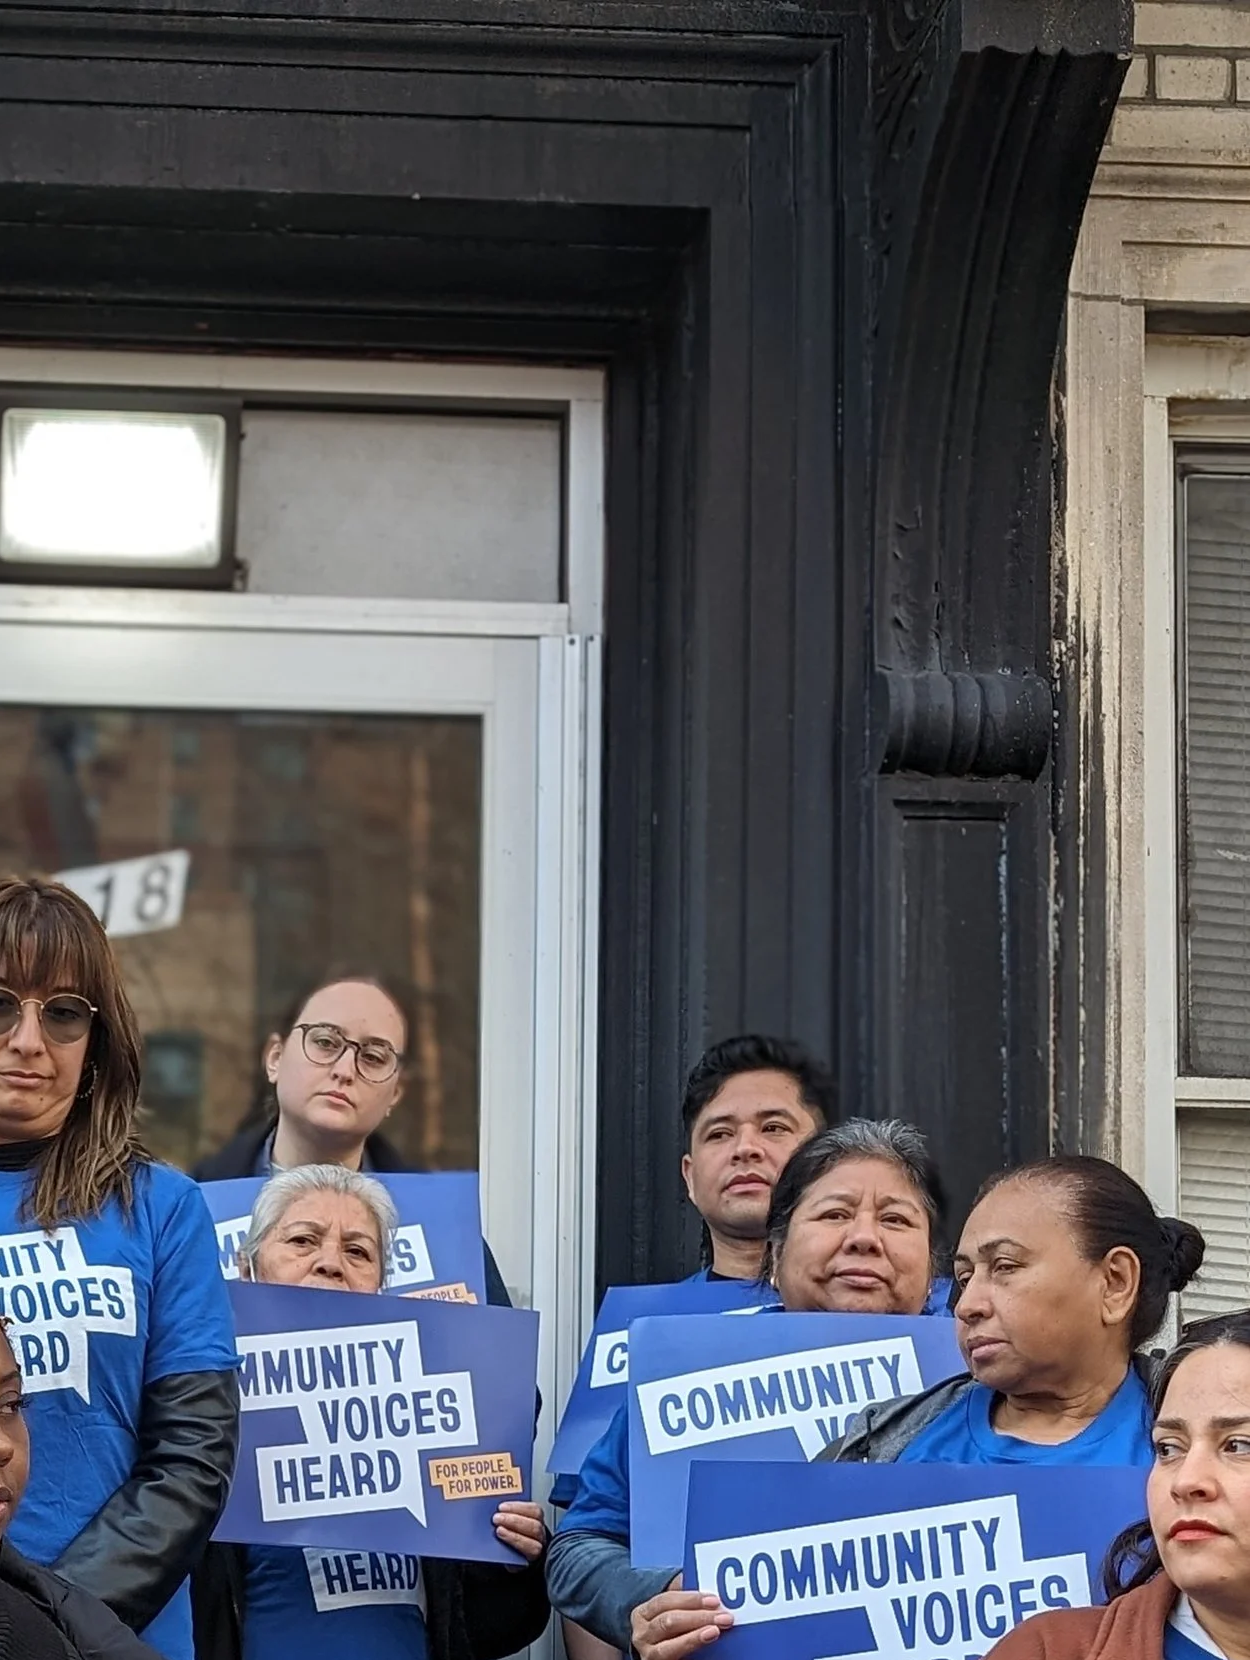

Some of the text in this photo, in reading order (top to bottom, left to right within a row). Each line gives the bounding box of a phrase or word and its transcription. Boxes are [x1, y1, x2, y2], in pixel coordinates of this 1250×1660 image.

[318, 1388, 461, 1444] VOICES
[658, 1353, 902, 1437] COMMUNITY
[273, 1449, 401, 1505] HEARD
[436, 1459, 508, 1478] FOR PEOPLE.
[449, 1474, 518, 1494] FOR POWER.
[320, 1552, 419, 1595] HEARD
[716, 1516, 1000, 1610] COMMUNITY
[890, 1574, 1071, 1650] VOICES
